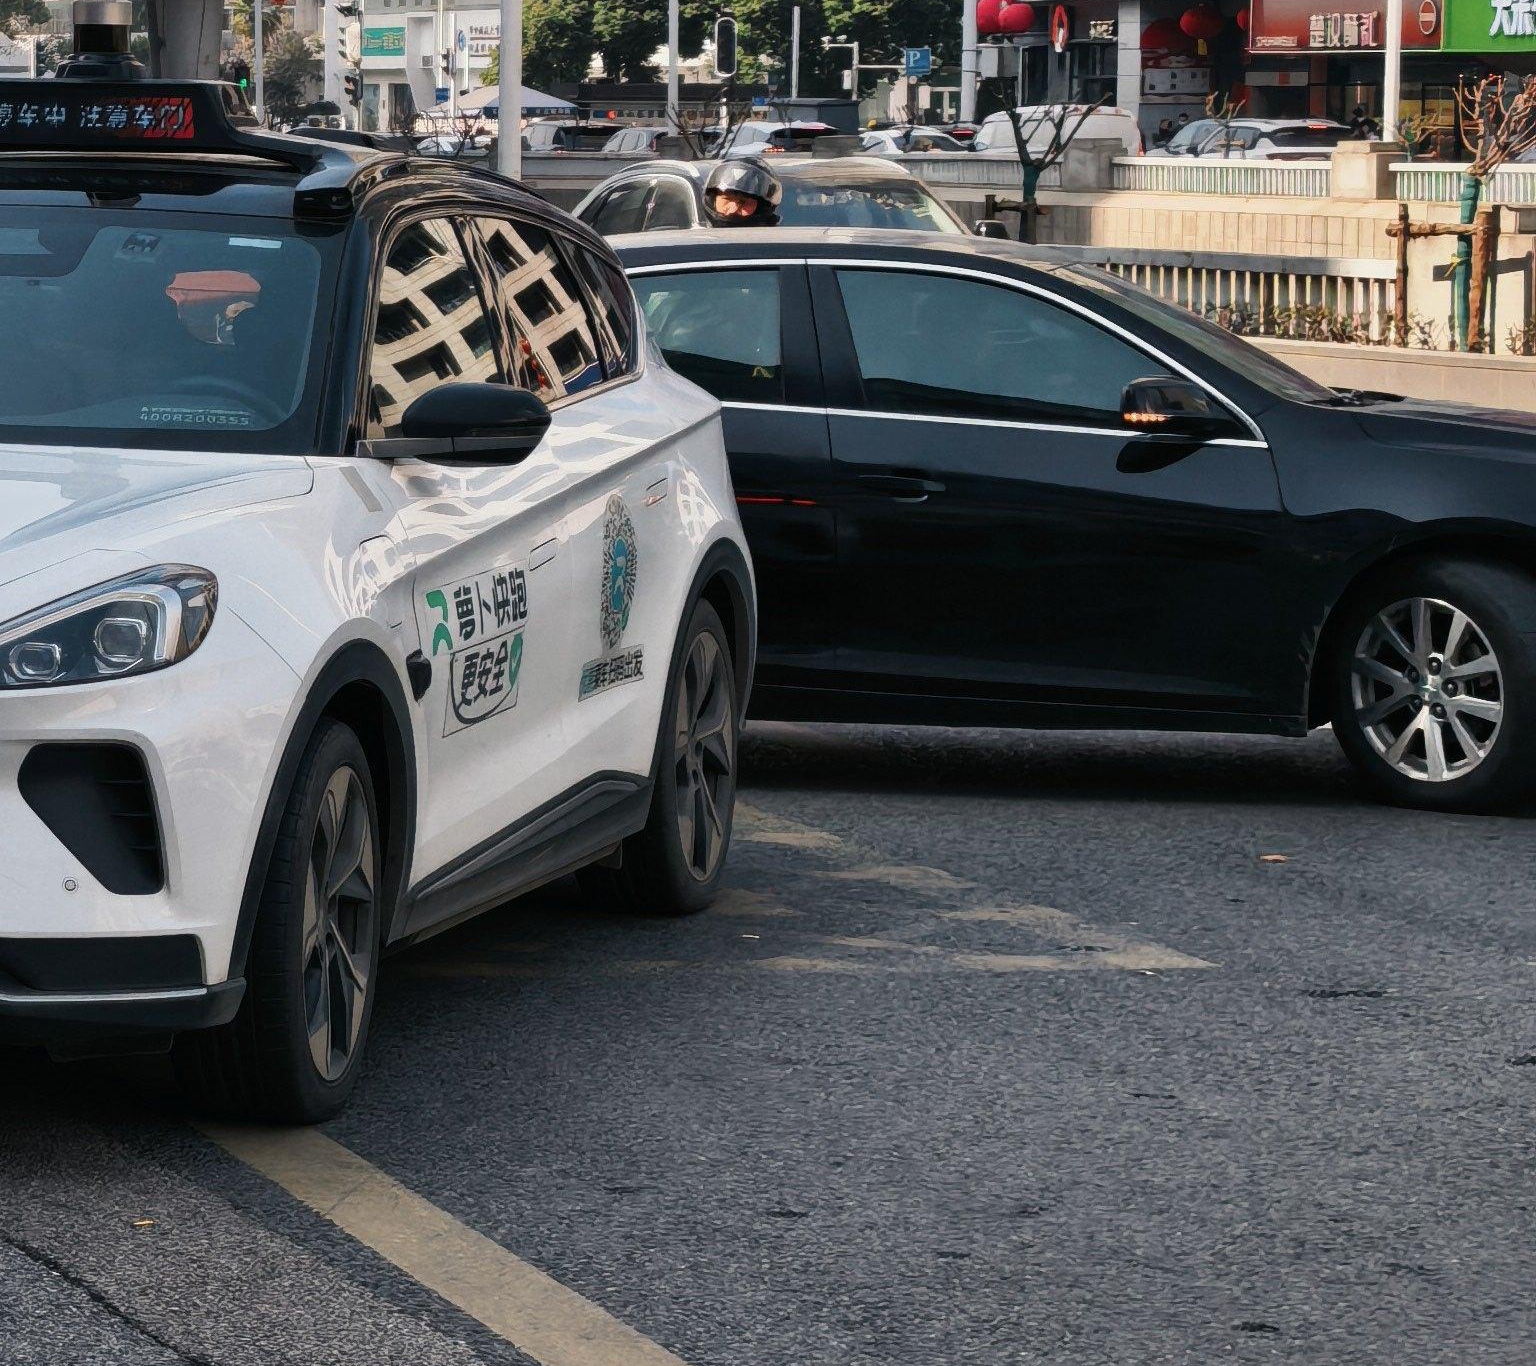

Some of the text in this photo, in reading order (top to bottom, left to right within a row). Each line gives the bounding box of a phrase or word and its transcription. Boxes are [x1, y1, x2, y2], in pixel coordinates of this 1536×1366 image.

[908, 50, 921, 67] P
[80, 102, 185, 130] 注意车门
[453, 567, 528, 642] 萝卜快跑
[462, 639, 509, 707] 更安全
